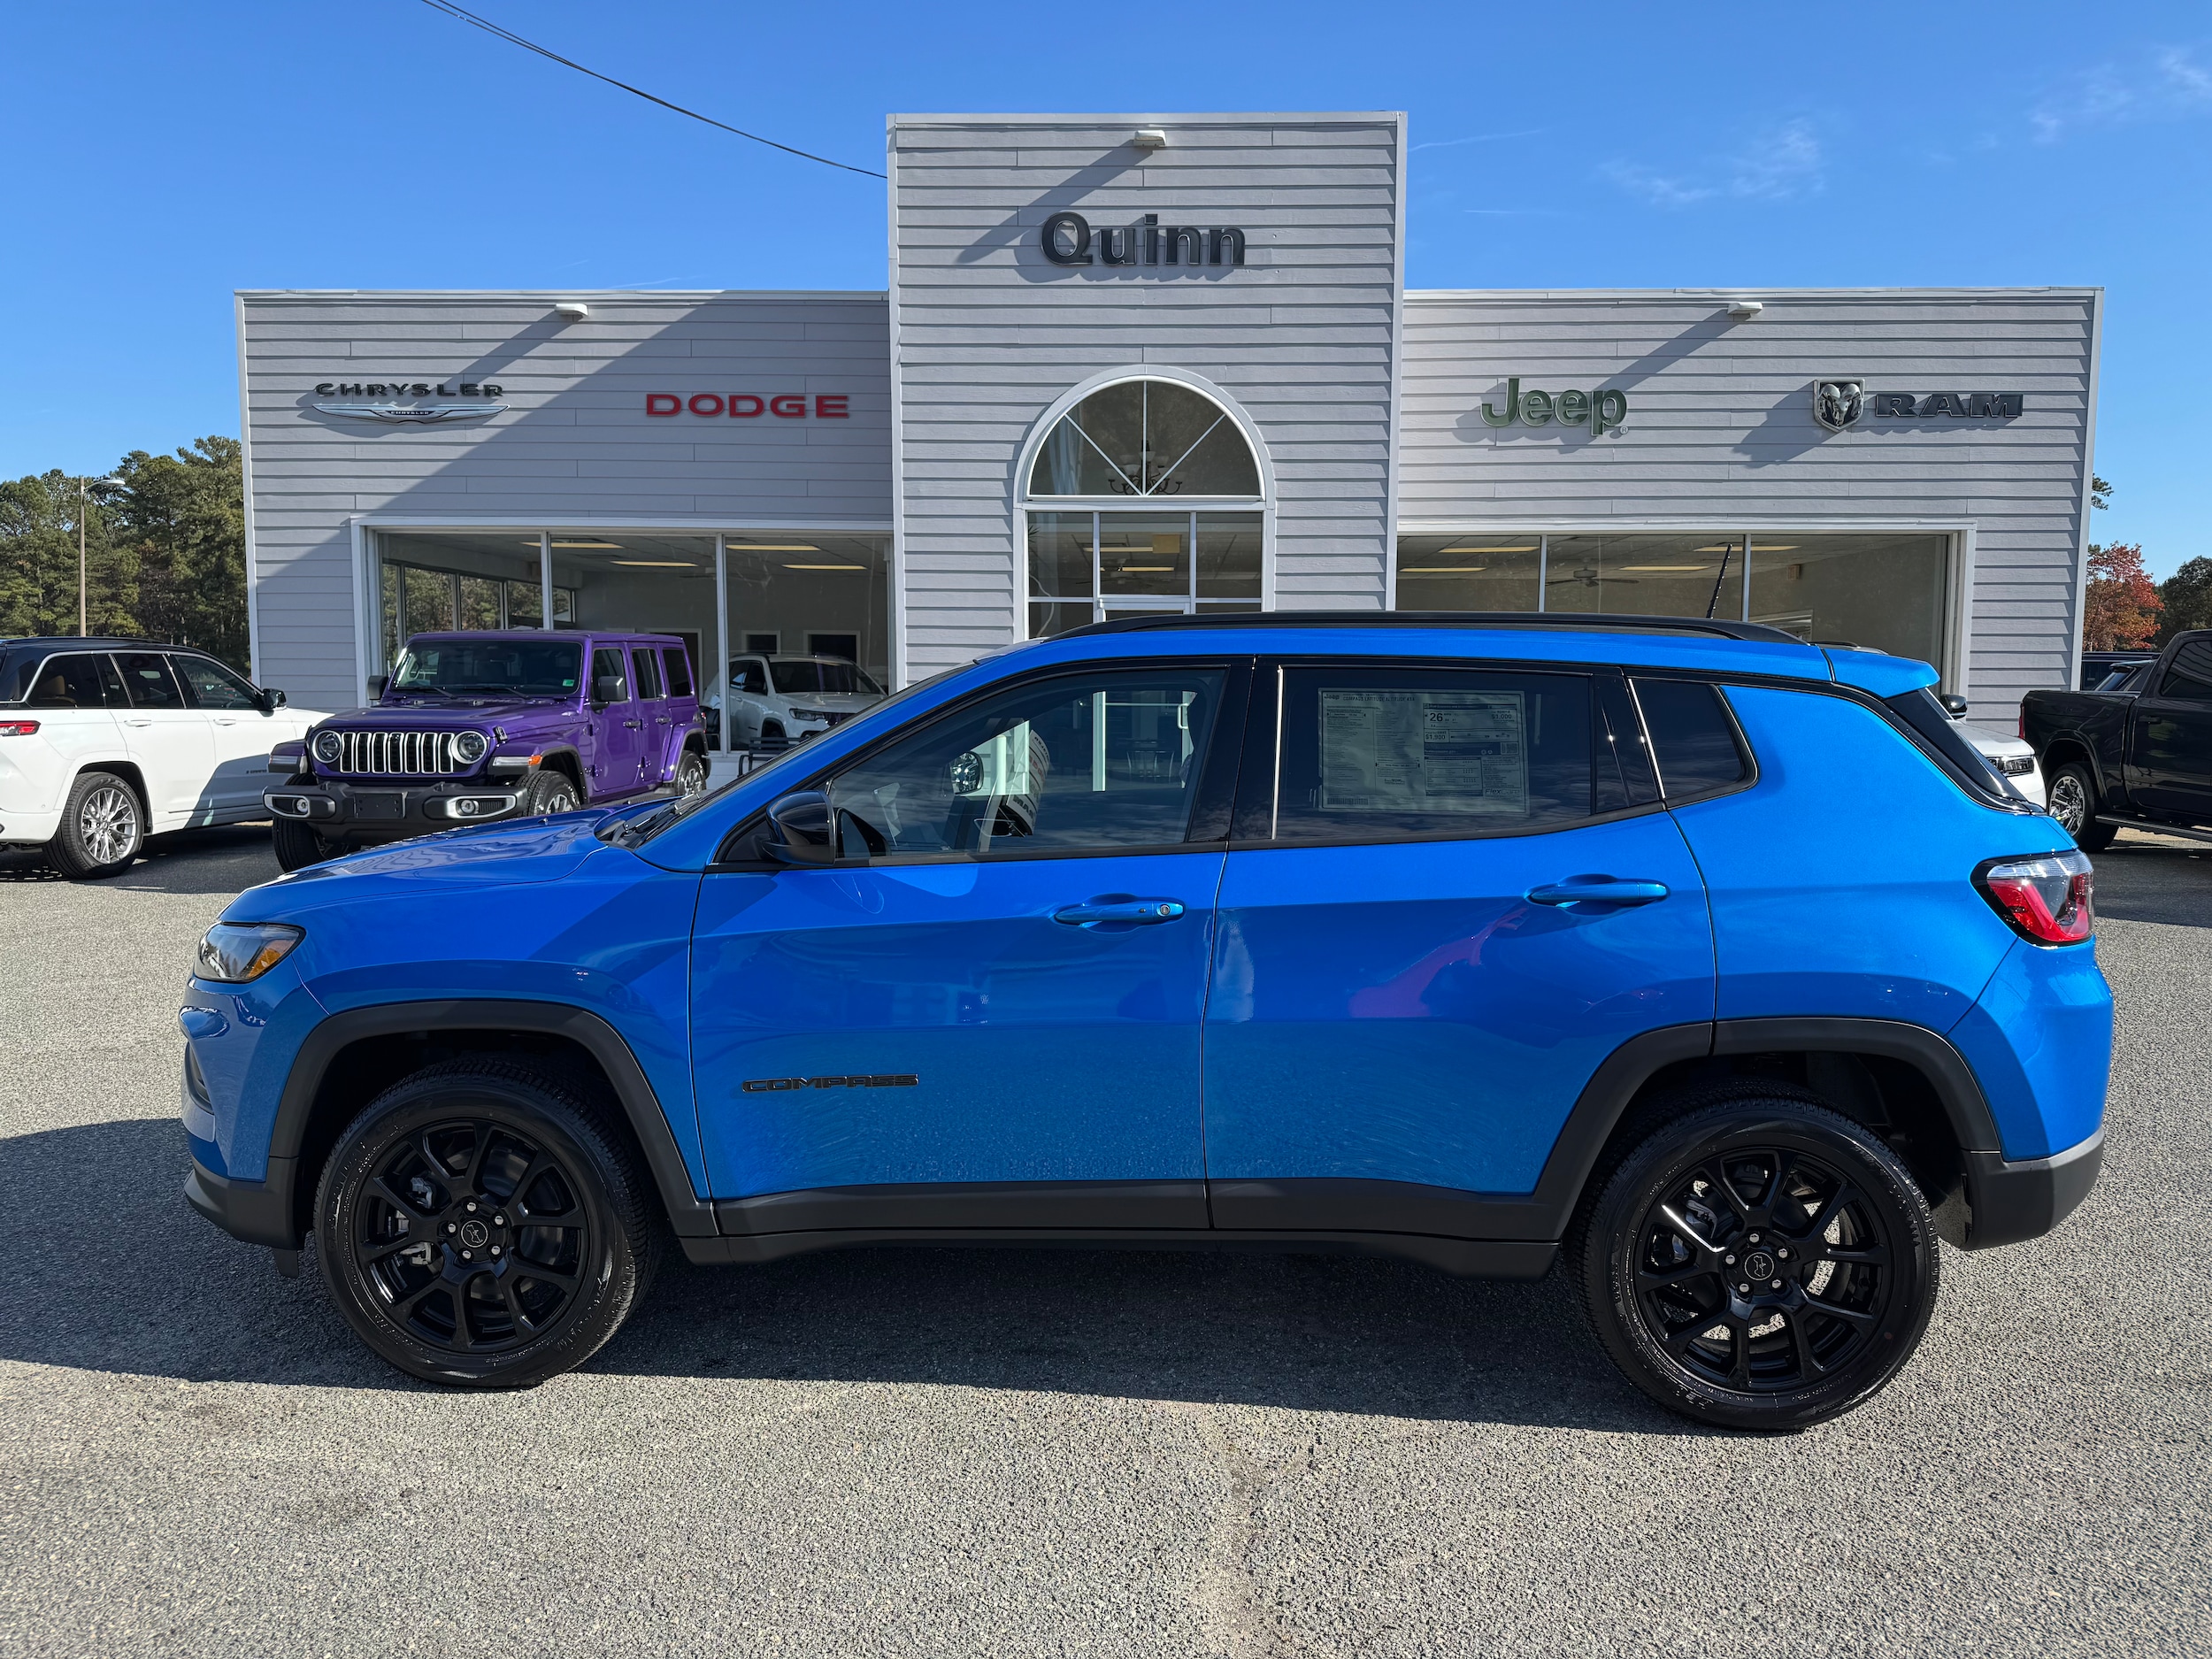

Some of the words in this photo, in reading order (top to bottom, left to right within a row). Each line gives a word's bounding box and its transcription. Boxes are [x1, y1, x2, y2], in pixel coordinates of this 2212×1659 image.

[1041, 211, 1246, 265] Quinn
[316, 383, 503, 397] CHRYSLER
[646, 394, 849, 419] DODGE
[1480, 378, 1627, 435] Jeep
[1876, 394, 2024, 418] RAM
[1430, 712, 1443, 722] 26
[742, 1074, 919, 1093] COMPASS
